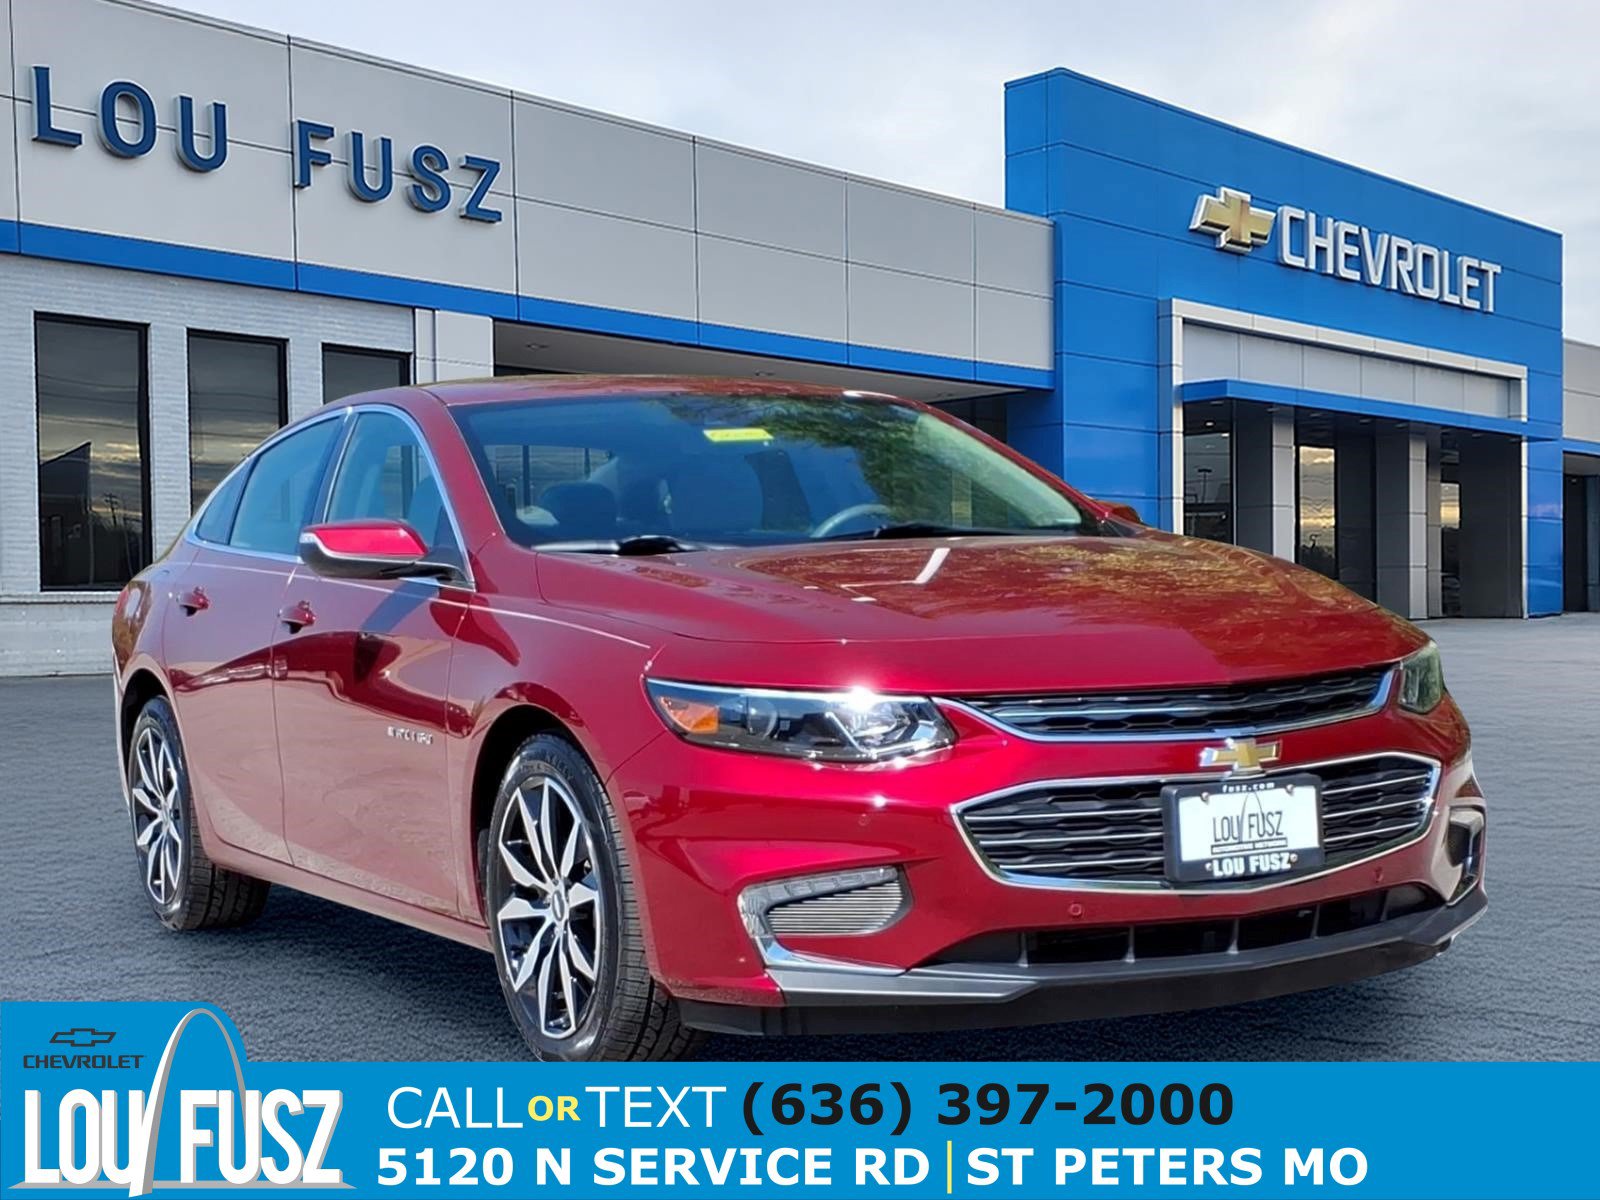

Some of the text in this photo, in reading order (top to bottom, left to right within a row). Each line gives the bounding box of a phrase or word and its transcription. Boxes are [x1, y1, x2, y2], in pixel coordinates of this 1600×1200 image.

[32, 66, 502, 223] LOU FUSZ
[1277, 204, 1501, 313] CHEVROLET
[1222, 782, 1275, 793] fusz.com
[1213, 811, 1283, 843] LOU FUSZ
[1212, 852, 1292, 878] LOU FUSZ
